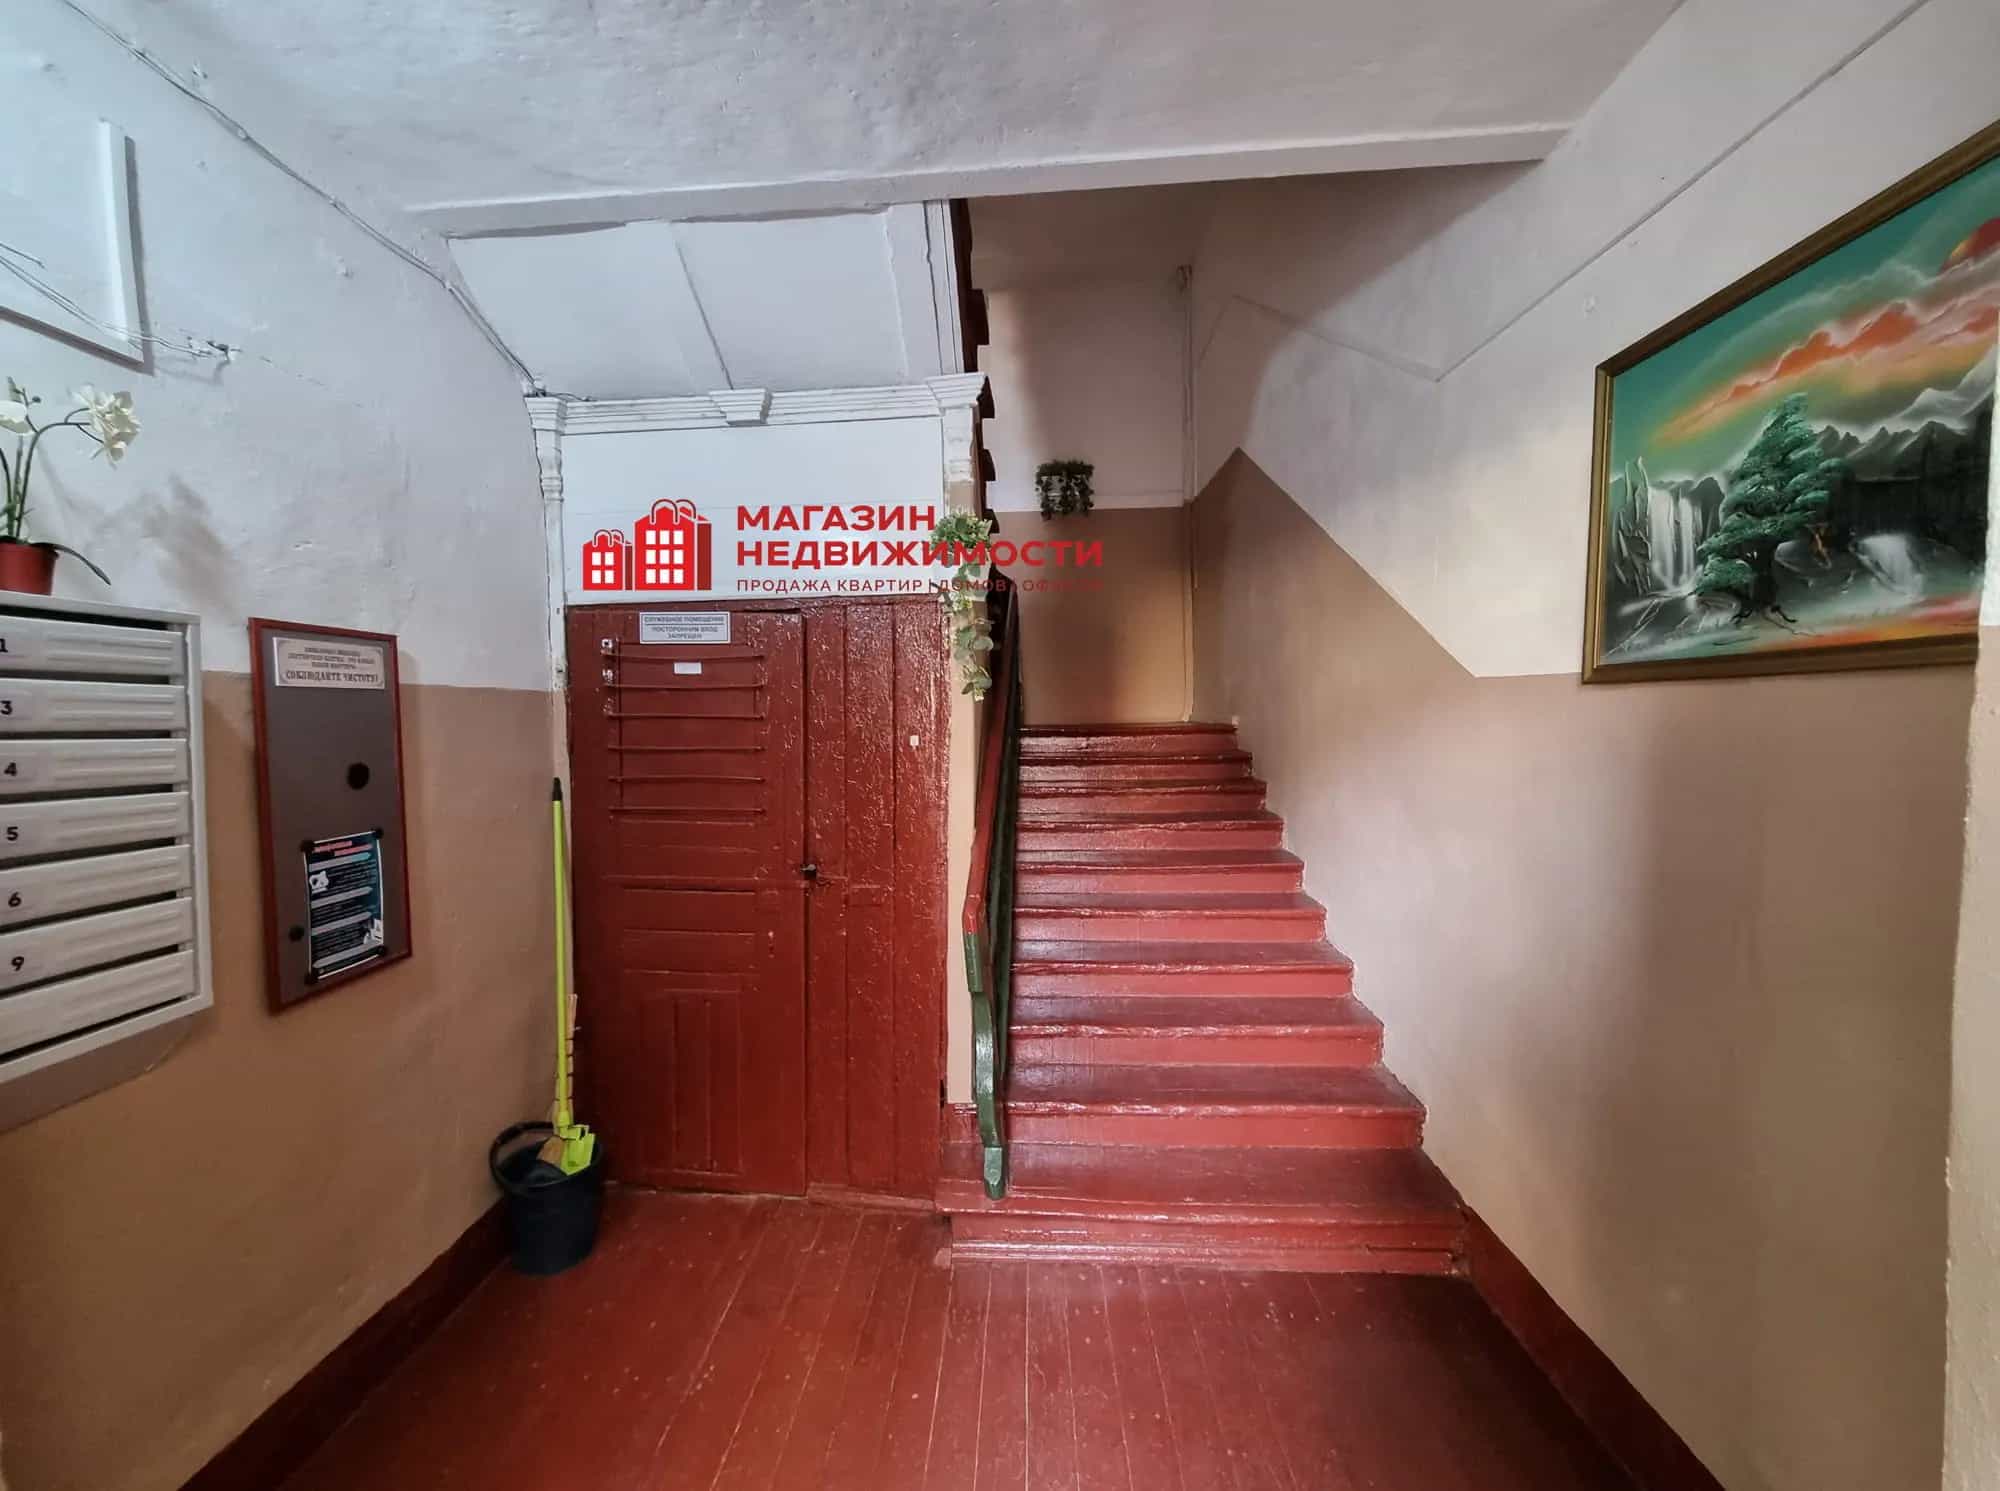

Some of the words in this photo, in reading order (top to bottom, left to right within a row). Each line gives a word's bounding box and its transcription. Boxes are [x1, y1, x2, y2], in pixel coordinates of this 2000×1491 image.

[0, 638, 8, 653] 1
[0, 700, 13, 715] 3
[4, 762, 17, 776] 4
[7, 826, 18, 841] 5
[8, 891, 21, 908] 6
[11, 956, 24, 972] 9
